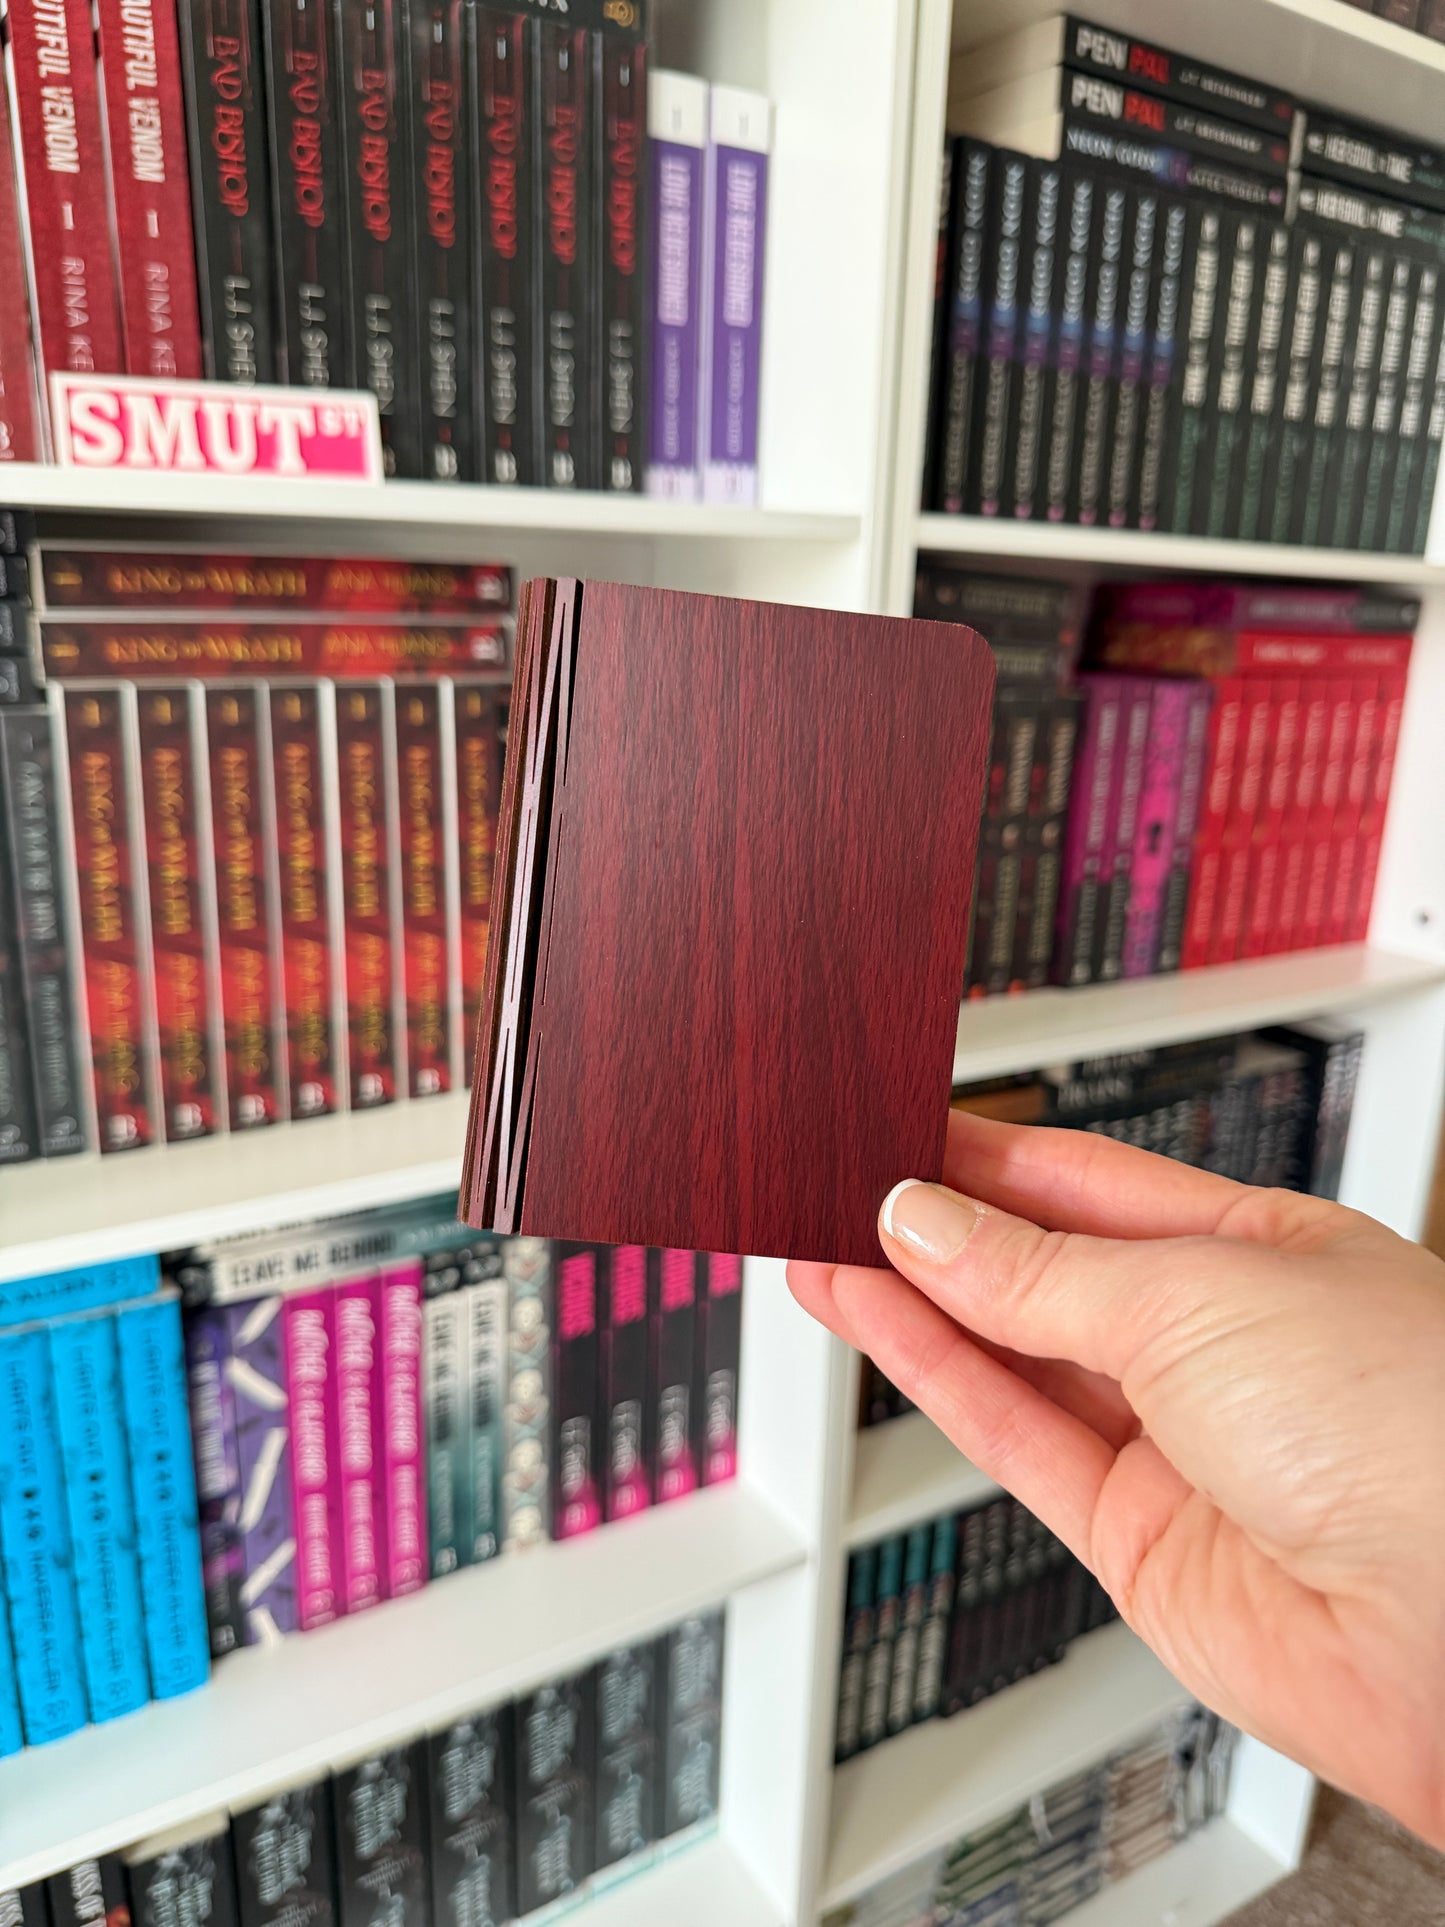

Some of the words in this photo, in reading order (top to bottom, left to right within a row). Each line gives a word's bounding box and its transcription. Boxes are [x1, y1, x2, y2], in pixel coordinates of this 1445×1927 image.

[1076, 25, 1128, 70] PEN
[1129, 43, 1169, 84] PAL
[41, 86, 80, 173] VENOM
[1071, 74, 1124, 119] PEN
[1124, 90, 1165, 132] PAL
[128, 97, 165, 183] VENOM
[62, 256, 89, 328] RINA
[145, 261, 172, 333] RINA
[67, 334, 94, 371] KE
[151, 336, 176, 377] KE
[225, 319, 256, 386] SHE
[300, 326, 329, 389] SHE
[68, 391, 307, 475] SMUT
